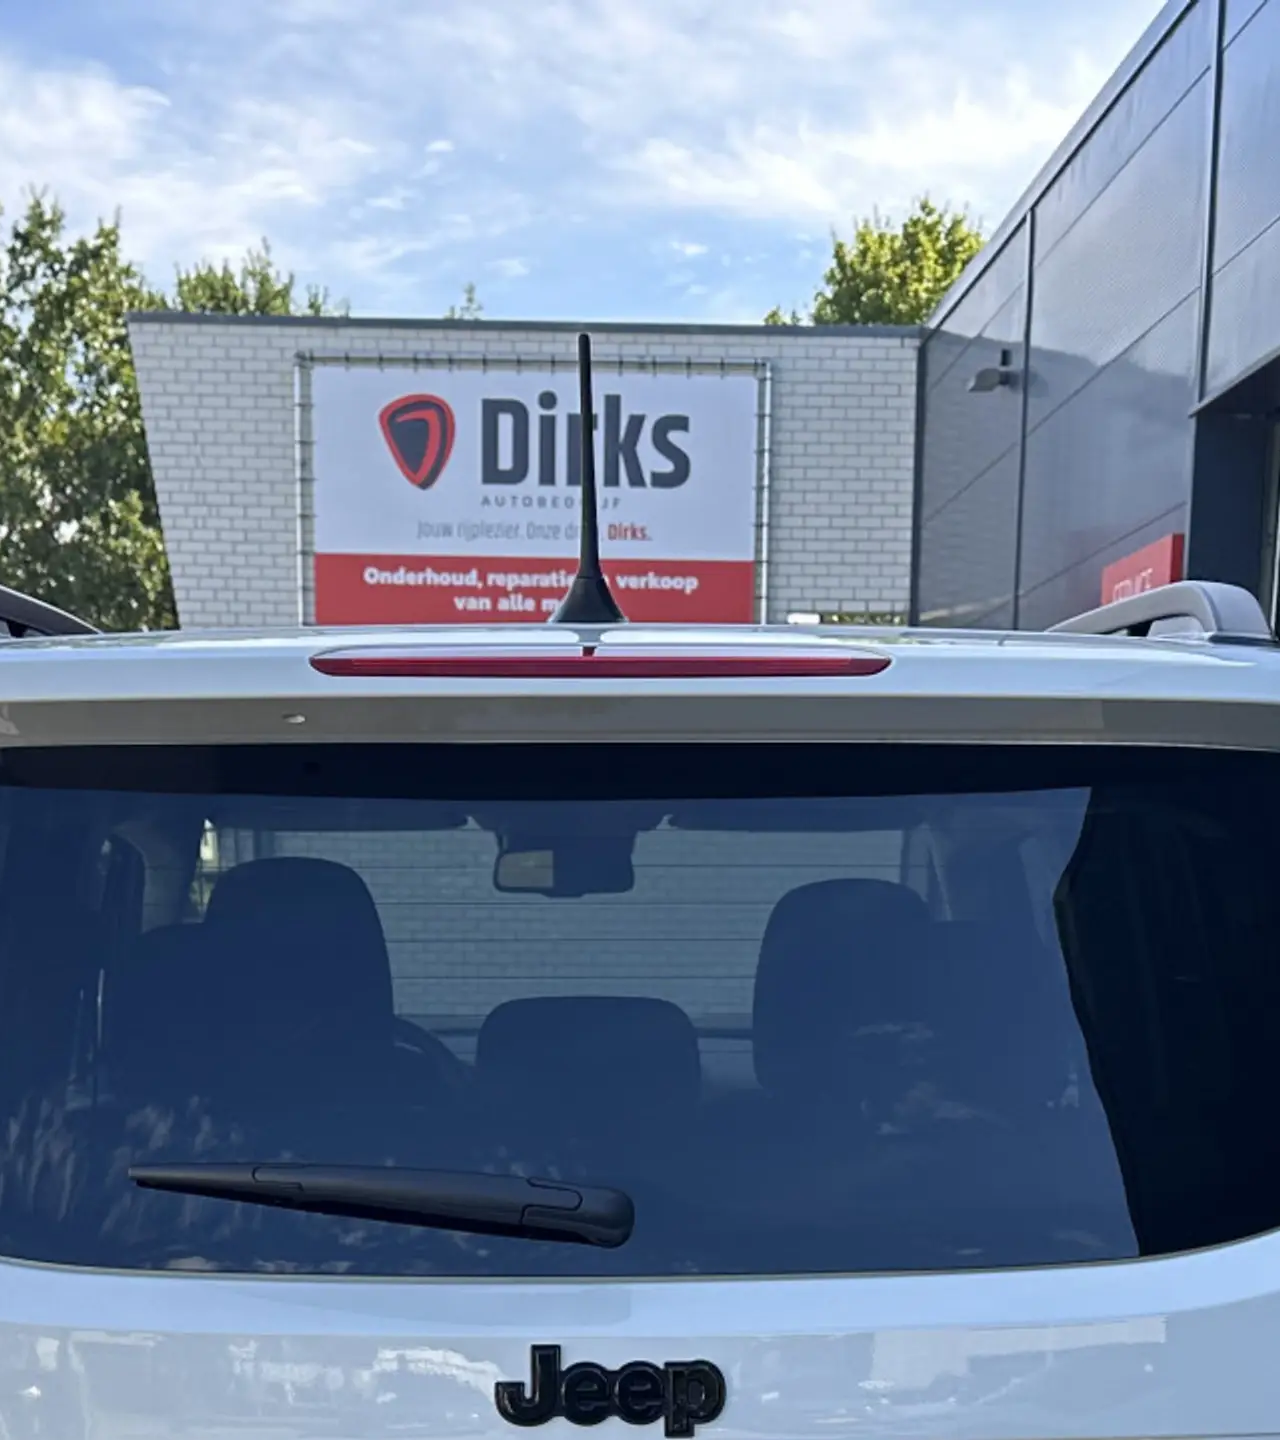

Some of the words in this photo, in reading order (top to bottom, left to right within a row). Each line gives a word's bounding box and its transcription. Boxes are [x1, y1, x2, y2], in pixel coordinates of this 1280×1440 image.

[481, 390, 691, 489] Dirks
[481, 495, 621, 510] AUTOBEDJF
[417, 520, 453, 541] Jouw
[526, 522, 560, 542] Onze
[363, 566, 483, 589] Onderhoud,
[616, 573, 699, 595] verkoop
[454, 596, 491, 611] van
[497, 593, 536, 612] alle
[495, 1344, 727, 1438] Jeep
